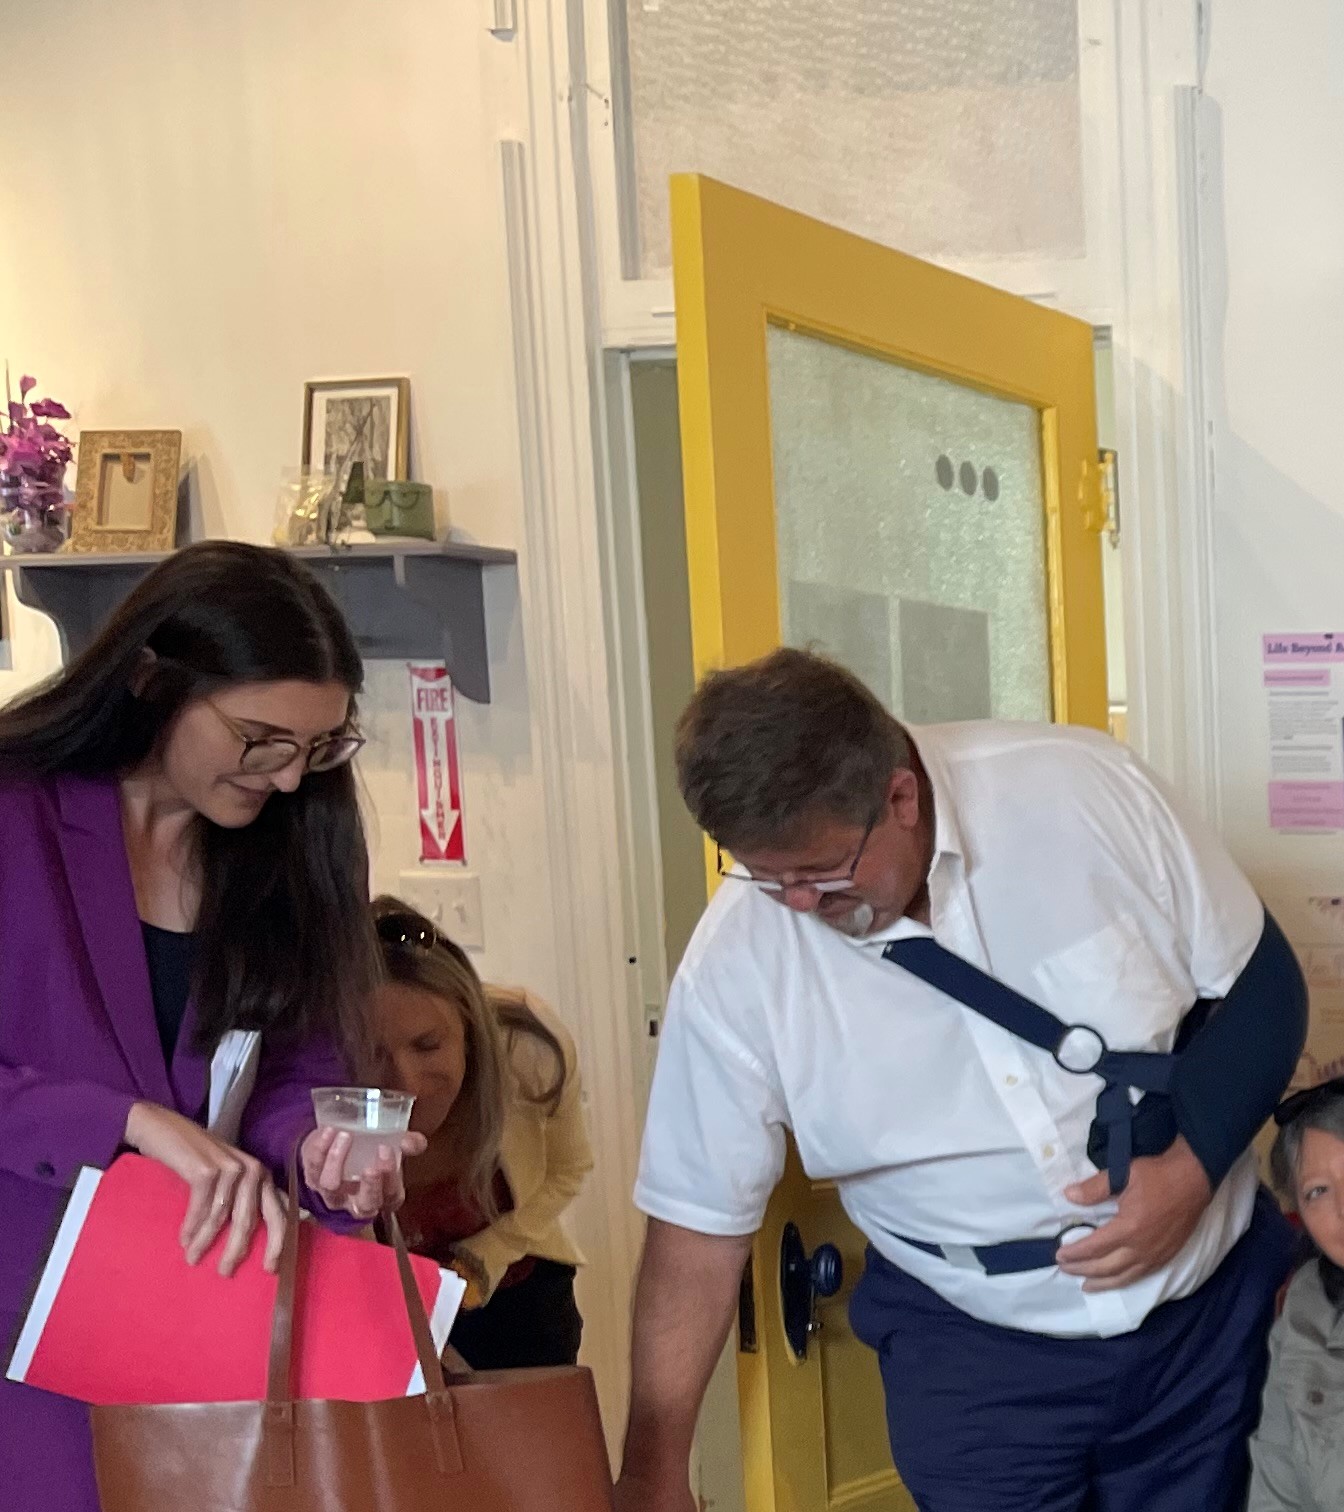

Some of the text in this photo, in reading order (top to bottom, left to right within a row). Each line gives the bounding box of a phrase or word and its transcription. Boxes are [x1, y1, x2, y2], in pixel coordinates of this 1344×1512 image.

[1267, 643, 1288, 654] Life
[1291, 643, 1332, 656] Beyond
[417, 688, 448, 712] FIRE
[430, 717, 446, 839] EXTINGUISHER
